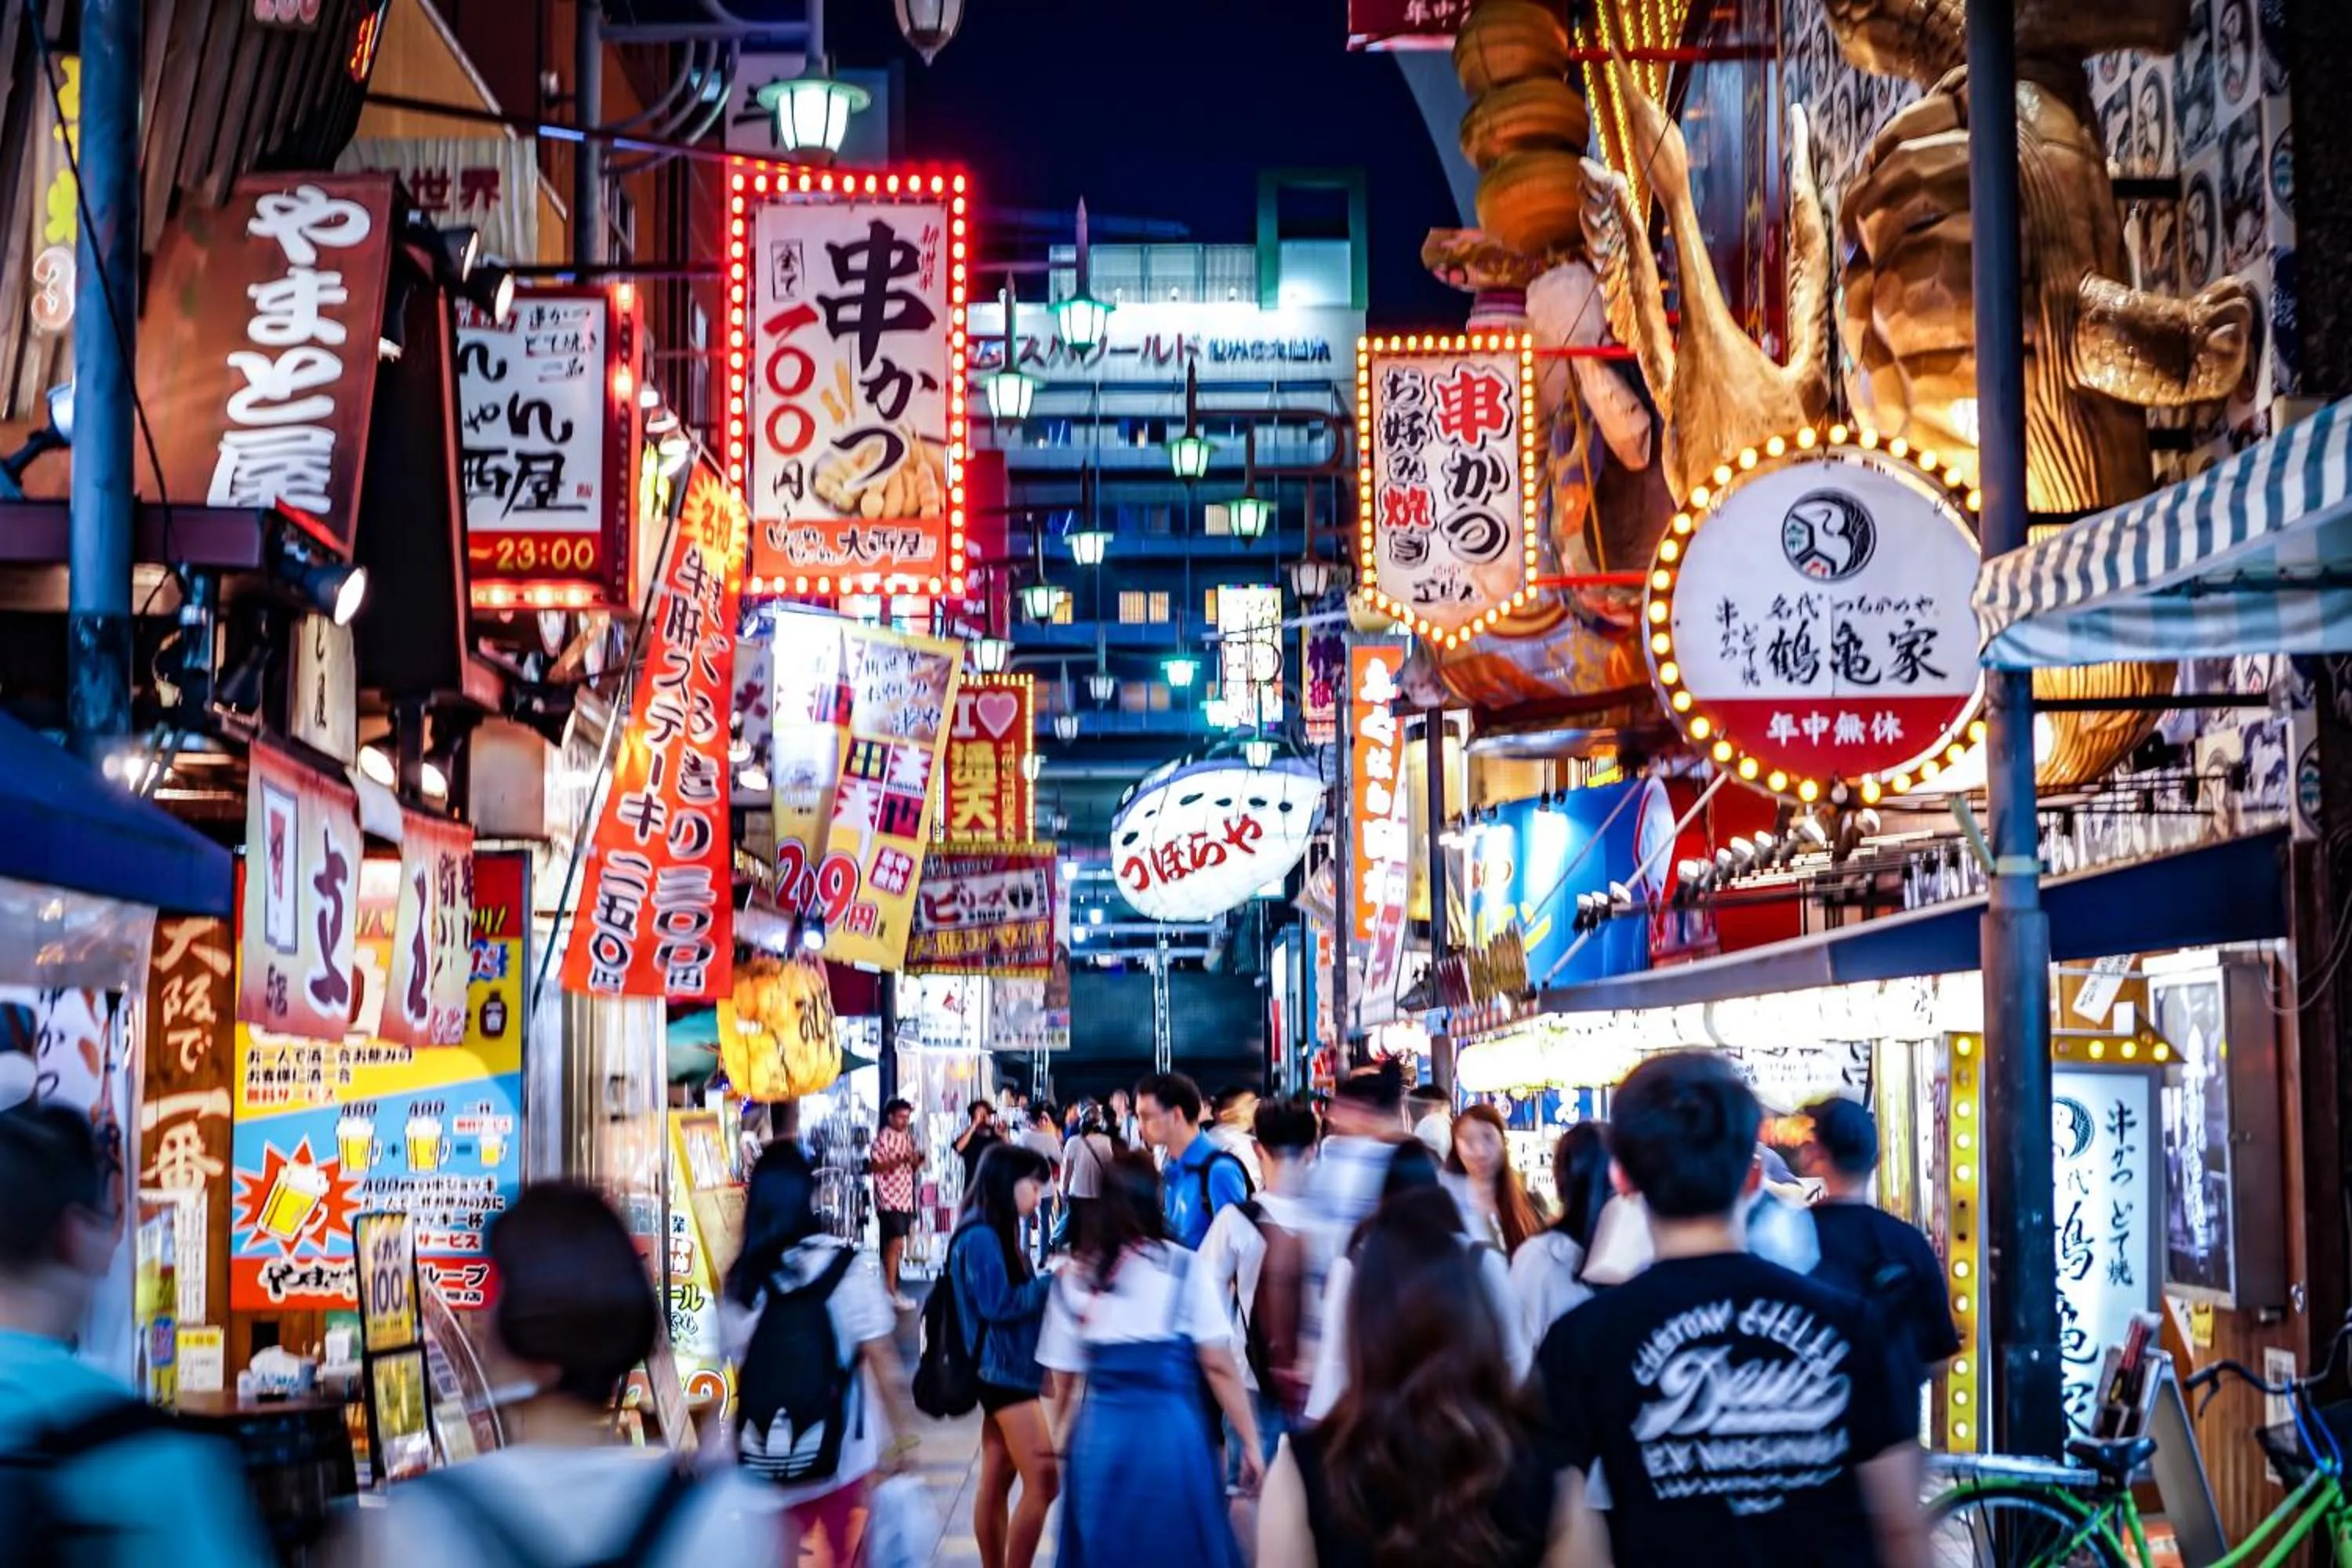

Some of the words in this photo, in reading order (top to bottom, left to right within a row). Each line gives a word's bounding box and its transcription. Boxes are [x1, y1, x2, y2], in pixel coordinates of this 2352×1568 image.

[376, 167, 500, 212] 世界
[815, 218, 938, 480] 串かつ
[1381, 370, 1432, 562] お好み焼き
[1437, 368, 1510, 563] 串かつ
[1766, 619, 1948, 686] 鶴亀家
[1766, 711, 1904, 747] 年中無休
[950, 740, 996, 843] 通天
